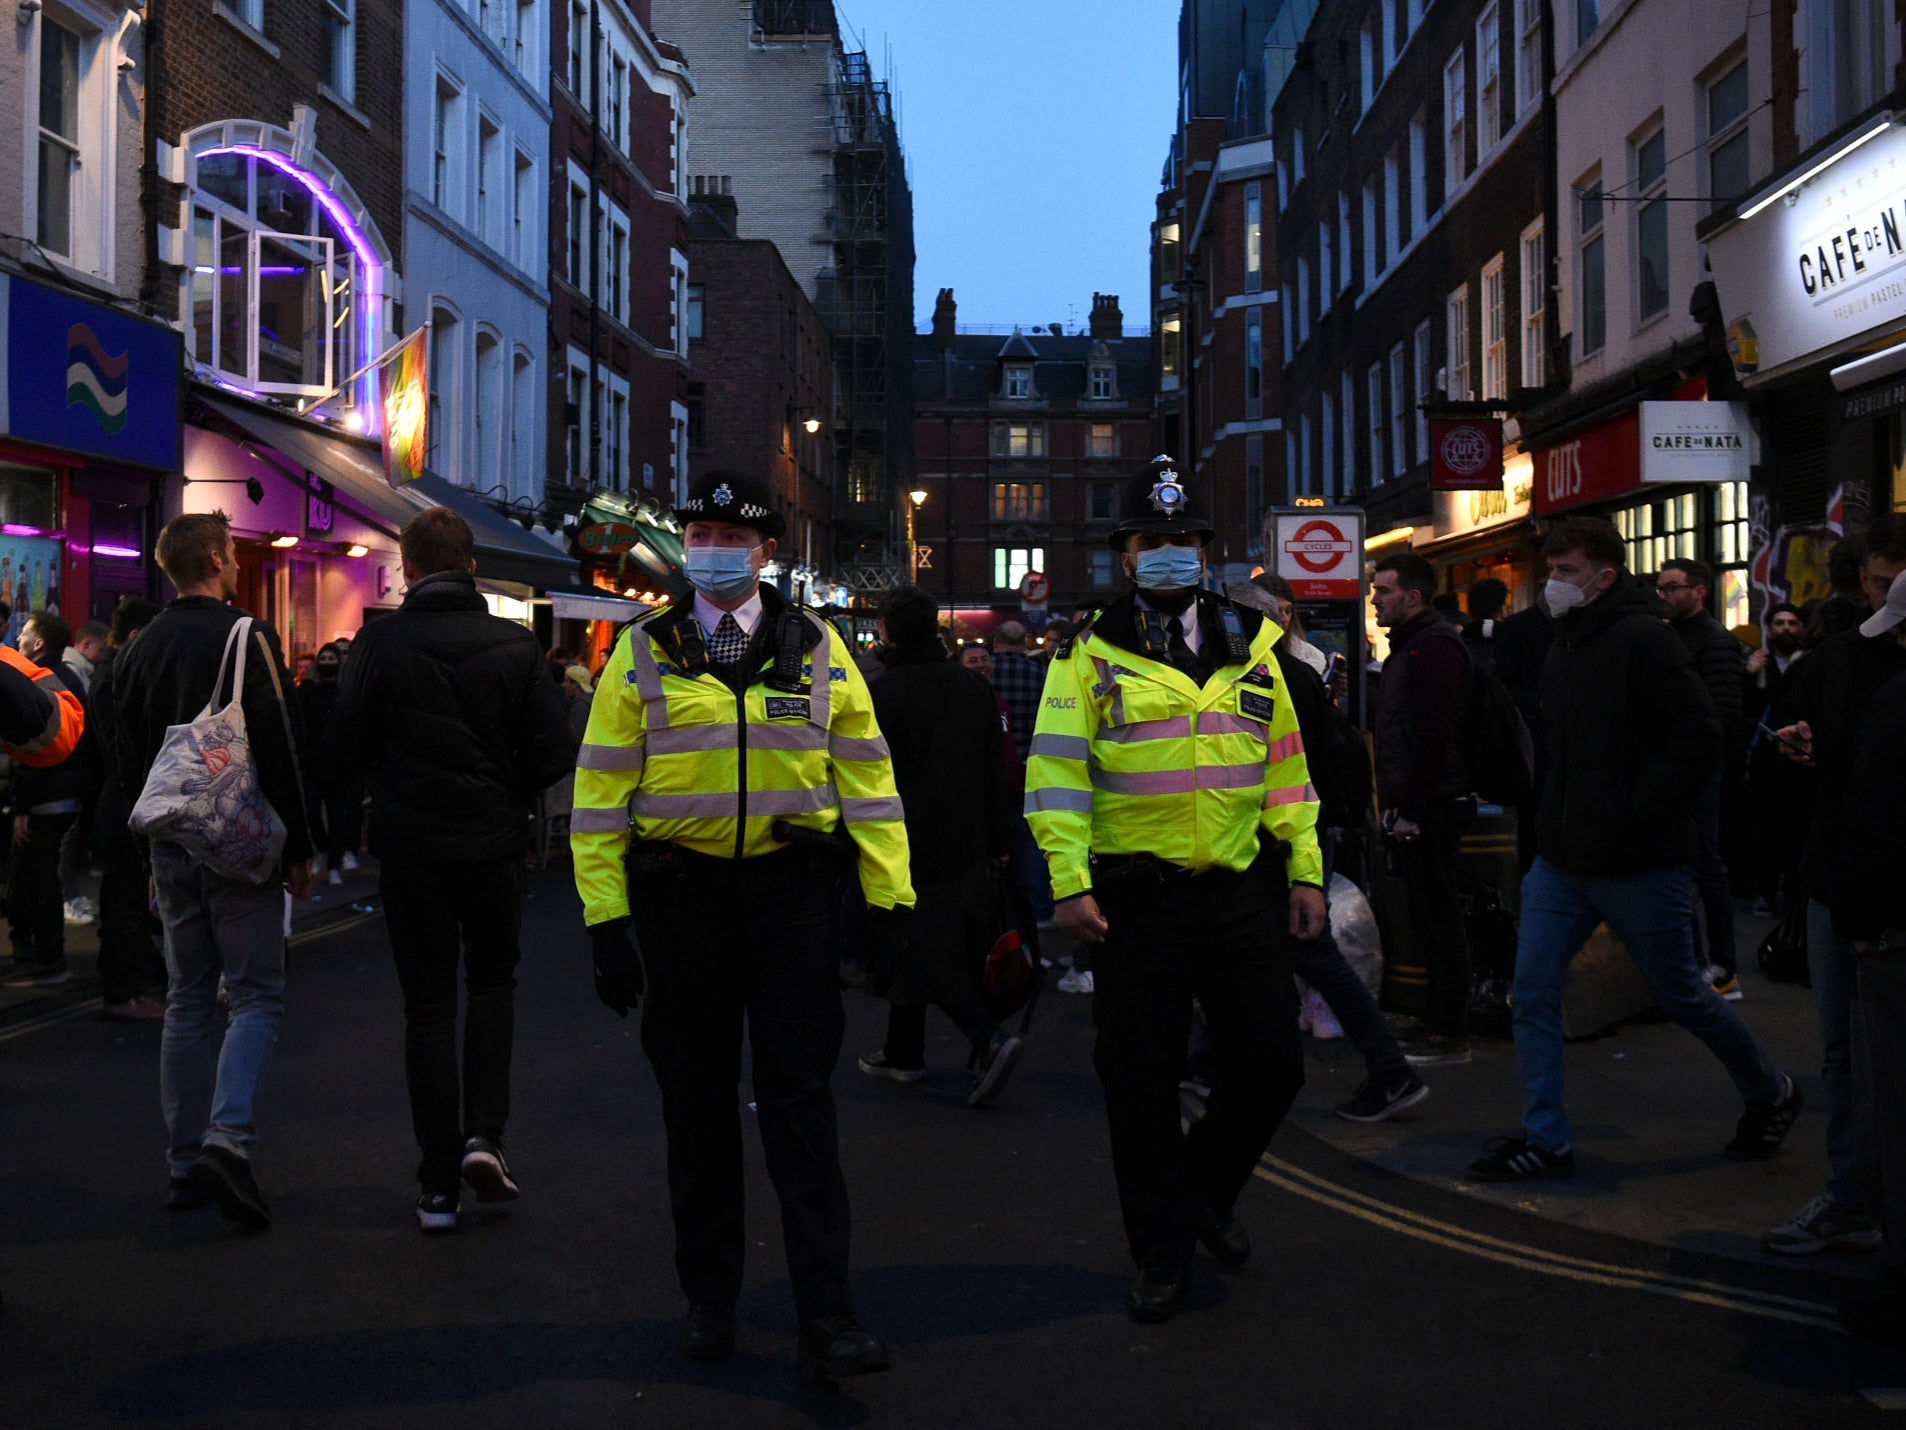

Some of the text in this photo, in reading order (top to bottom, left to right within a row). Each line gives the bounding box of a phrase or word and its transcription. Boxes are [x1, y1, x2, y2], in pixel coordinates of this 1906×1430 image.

[1863, 226, 1882, 251] DE
[1704, 435, 1742, 449] NATA
[1547, 440, 1581, 503] CUTS
[1304, 543, 1333, 551] CYCLES
[1045, 696, 1077, 709] POLICE
